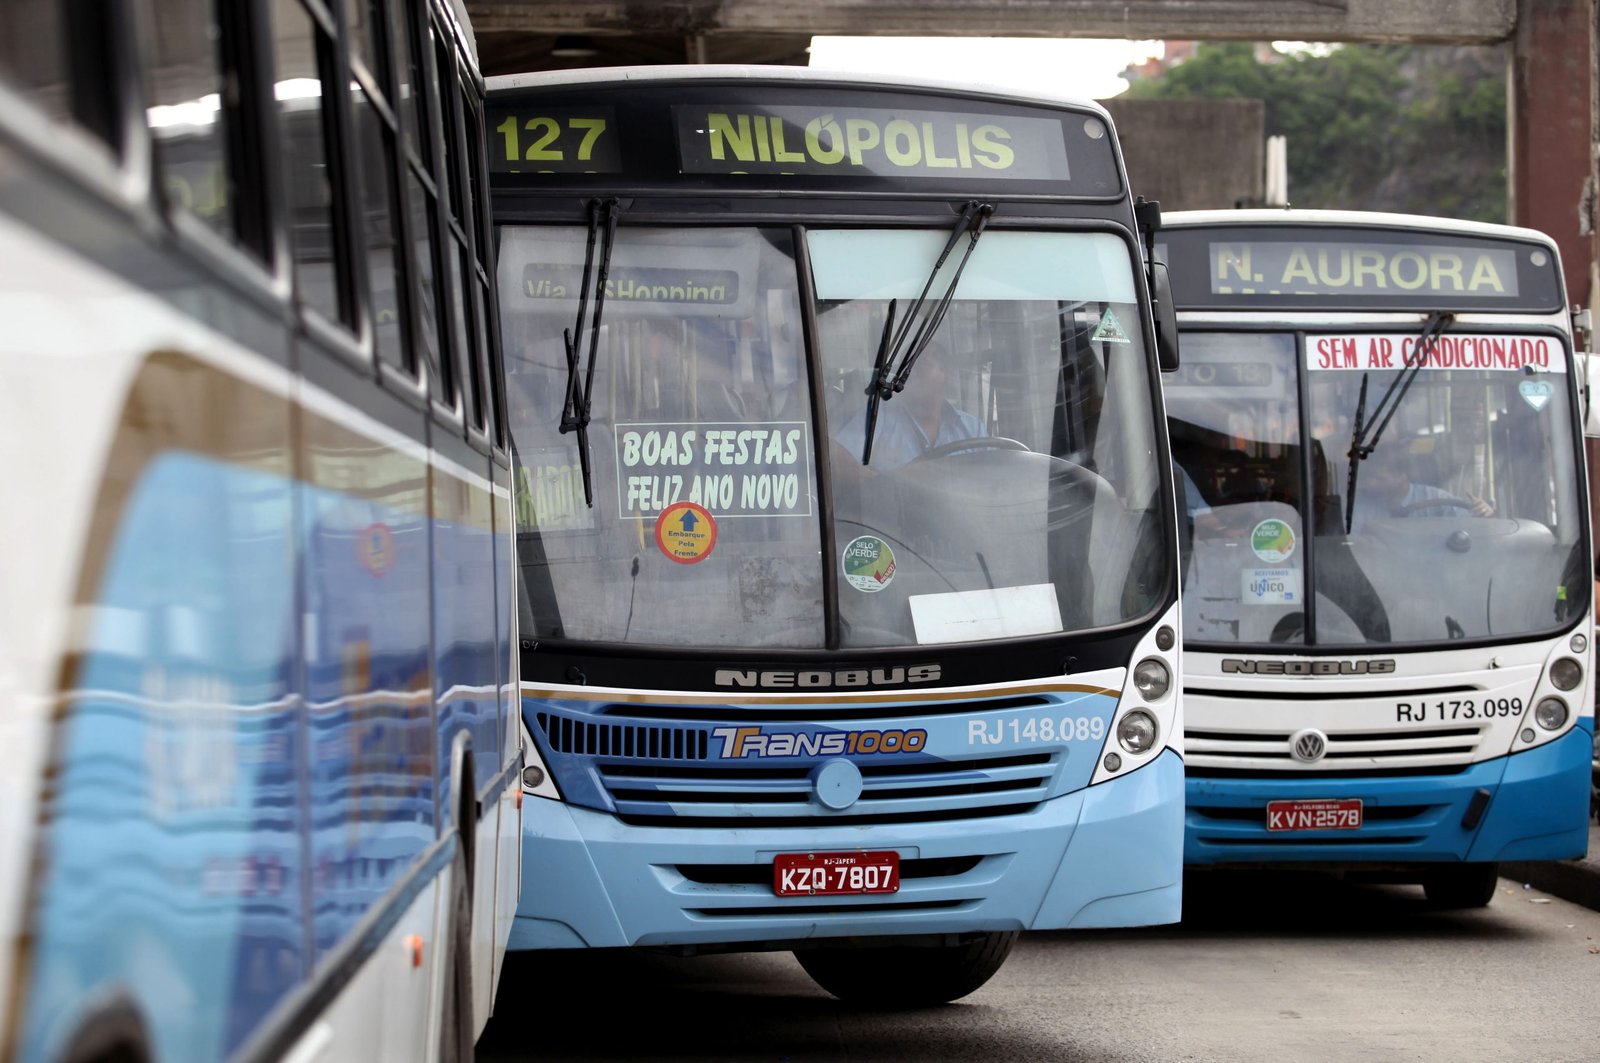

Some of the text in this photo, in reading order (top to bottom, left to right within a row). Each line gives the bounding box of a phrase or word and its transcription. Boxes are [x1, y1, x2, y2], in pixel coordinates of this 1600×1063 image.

[497, 116, 606, 161] 127
[708, 113, 1015, 170] NILÓPOLIS
[1218, 246, 1504, 293] N. AURORA
[1317, 337, 1549, 369] SEM AR CONDICIONADO
[623, 430, 800, 467] BOAS FESTAS
[627, 475, 683, 511] FELIZ
[689, 475, 734, 510] ANO
[741, 474, 798, 510] NOVO
[850, 548, 878, 559] VERDE
[856, 541, 873, 549] SELO
[1250, 580, 1284, 593] ÚNICO
[715, 664, 942, 688] NEOBUS
[1221, 658, 1396, 676] NEOBUS
[1396, 698, 1523, 722] RJ 173.099
[968, 716, 1105, 745] RJ 148.089
